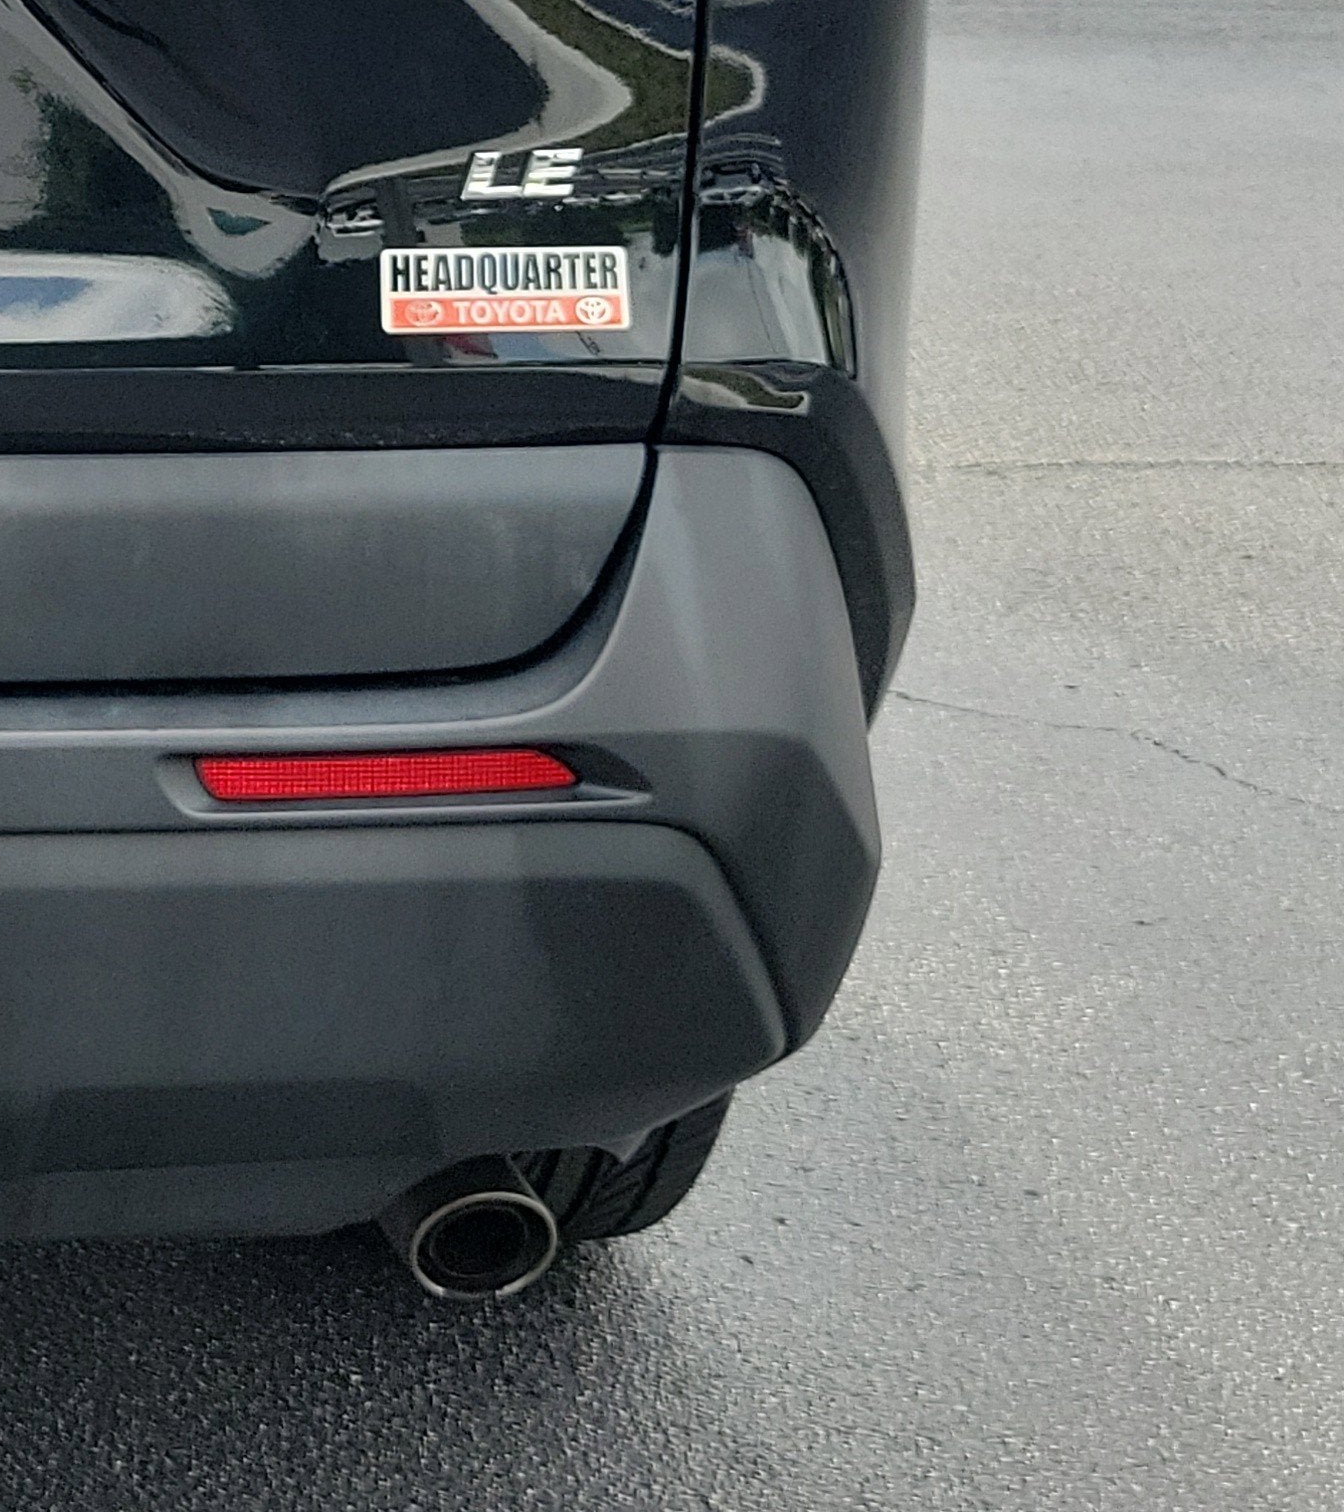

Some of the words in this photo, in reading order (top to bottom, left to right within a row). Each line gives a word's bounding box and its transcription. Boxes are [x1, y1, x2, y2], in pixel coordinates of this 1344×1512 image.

[460, 147, 585, 201] LE
[388, 251, 619, 294] HEADQUARTER
[452, 299, 567, 324] TOYOTA
